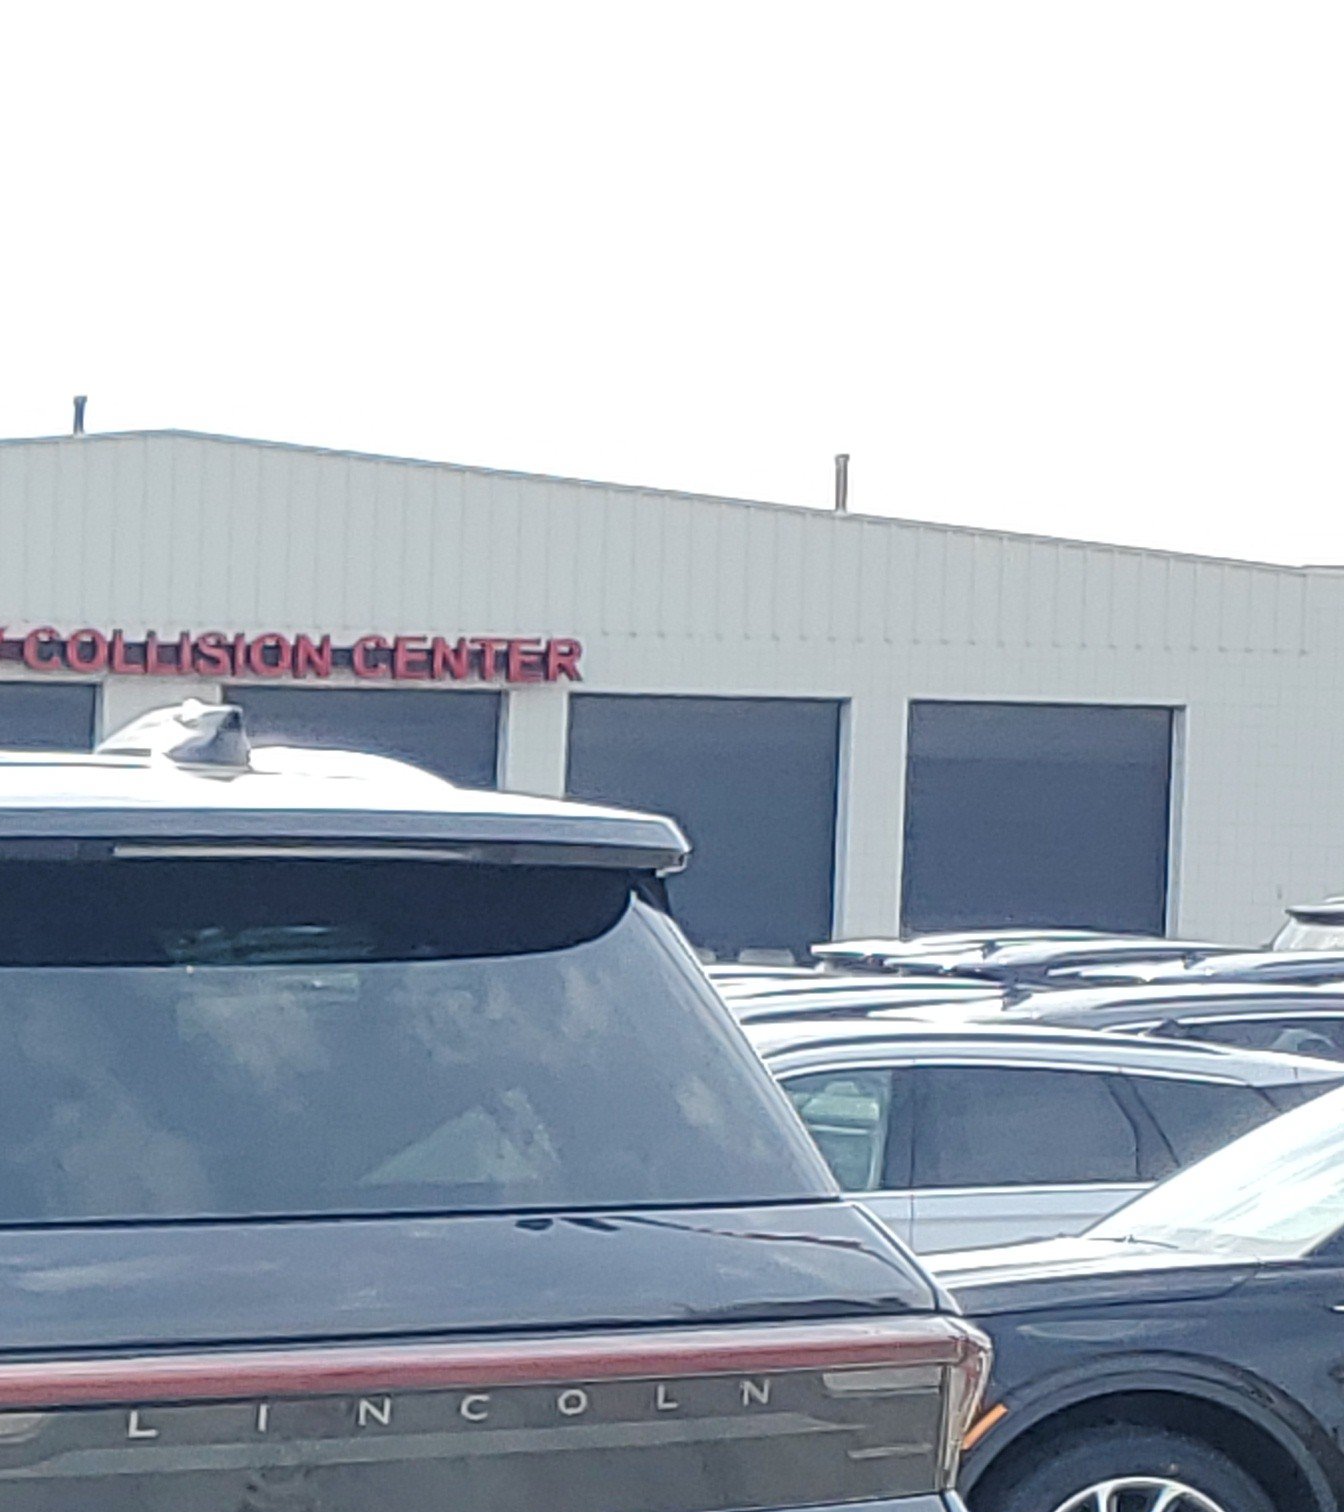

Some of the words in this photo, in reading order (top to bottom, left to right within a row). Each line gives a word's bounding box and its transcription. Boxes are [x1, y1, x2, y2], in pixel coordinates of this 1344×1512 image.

[23, 626, 333, 678] COLLISION
[353, 636, 584, 682] CENTER
[128, 1379, 770, 1438] LINCOLN
